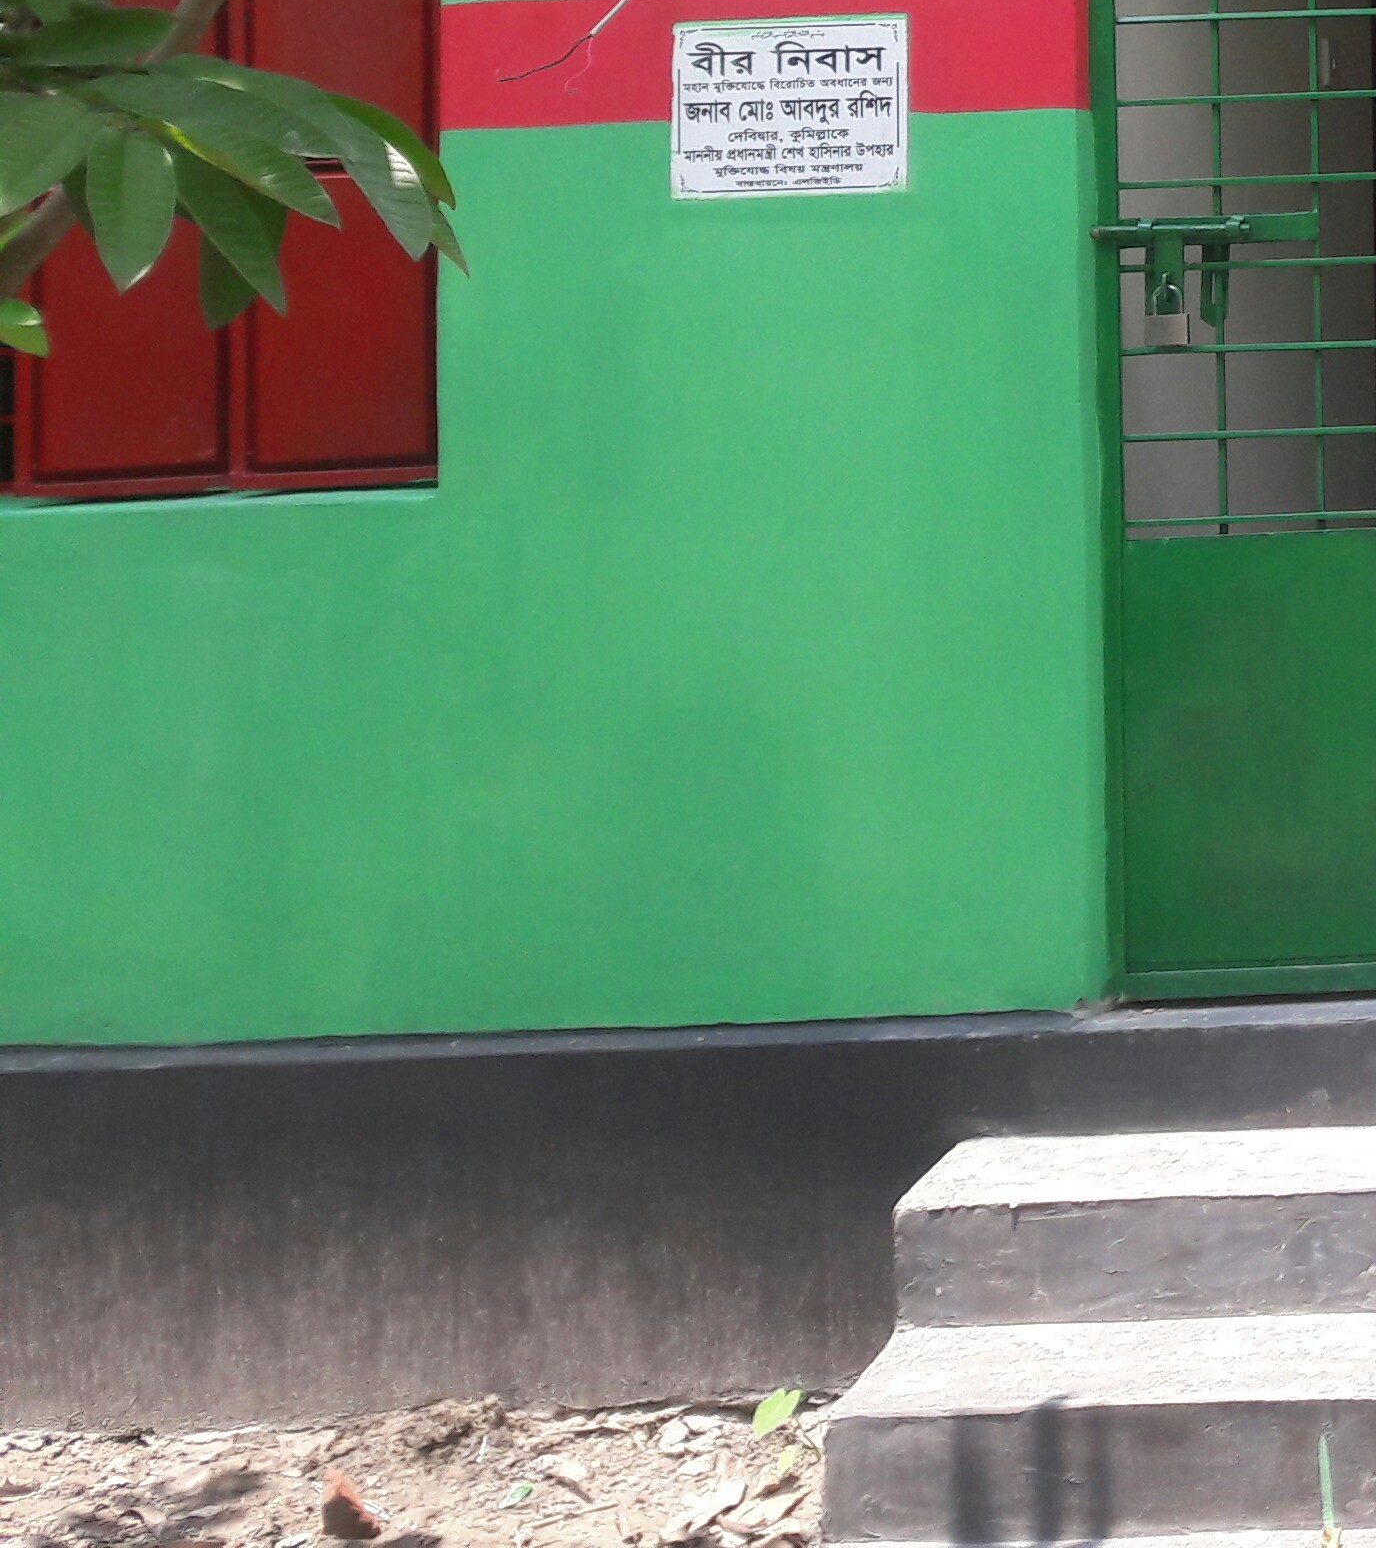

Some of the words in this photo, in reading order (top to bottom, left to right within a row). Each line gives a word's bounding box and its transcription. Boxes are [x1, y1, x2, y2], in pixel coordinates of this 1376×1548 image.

[687, 42, 756, 77] বীর
[770, 41, 886, 75] নিবাস
[683, 99, 732, 124] জনাব
[739, 98, 774, 122] মোঃ
[779, 97, 840, 125] আবদুর
[845, 89, 893, 119] রশিদ
[788, 126, 850, 143] কুমিল্লাকে
[683, 145, 723, 163] মাননীয়
[726, 143, 777, 162] প্রধানমন্ত্রী
[781, 147, 804, 160] শেখ
[807, 142, 851, 160] হাসিনার
[855, 142, 894, 158] উপহার
